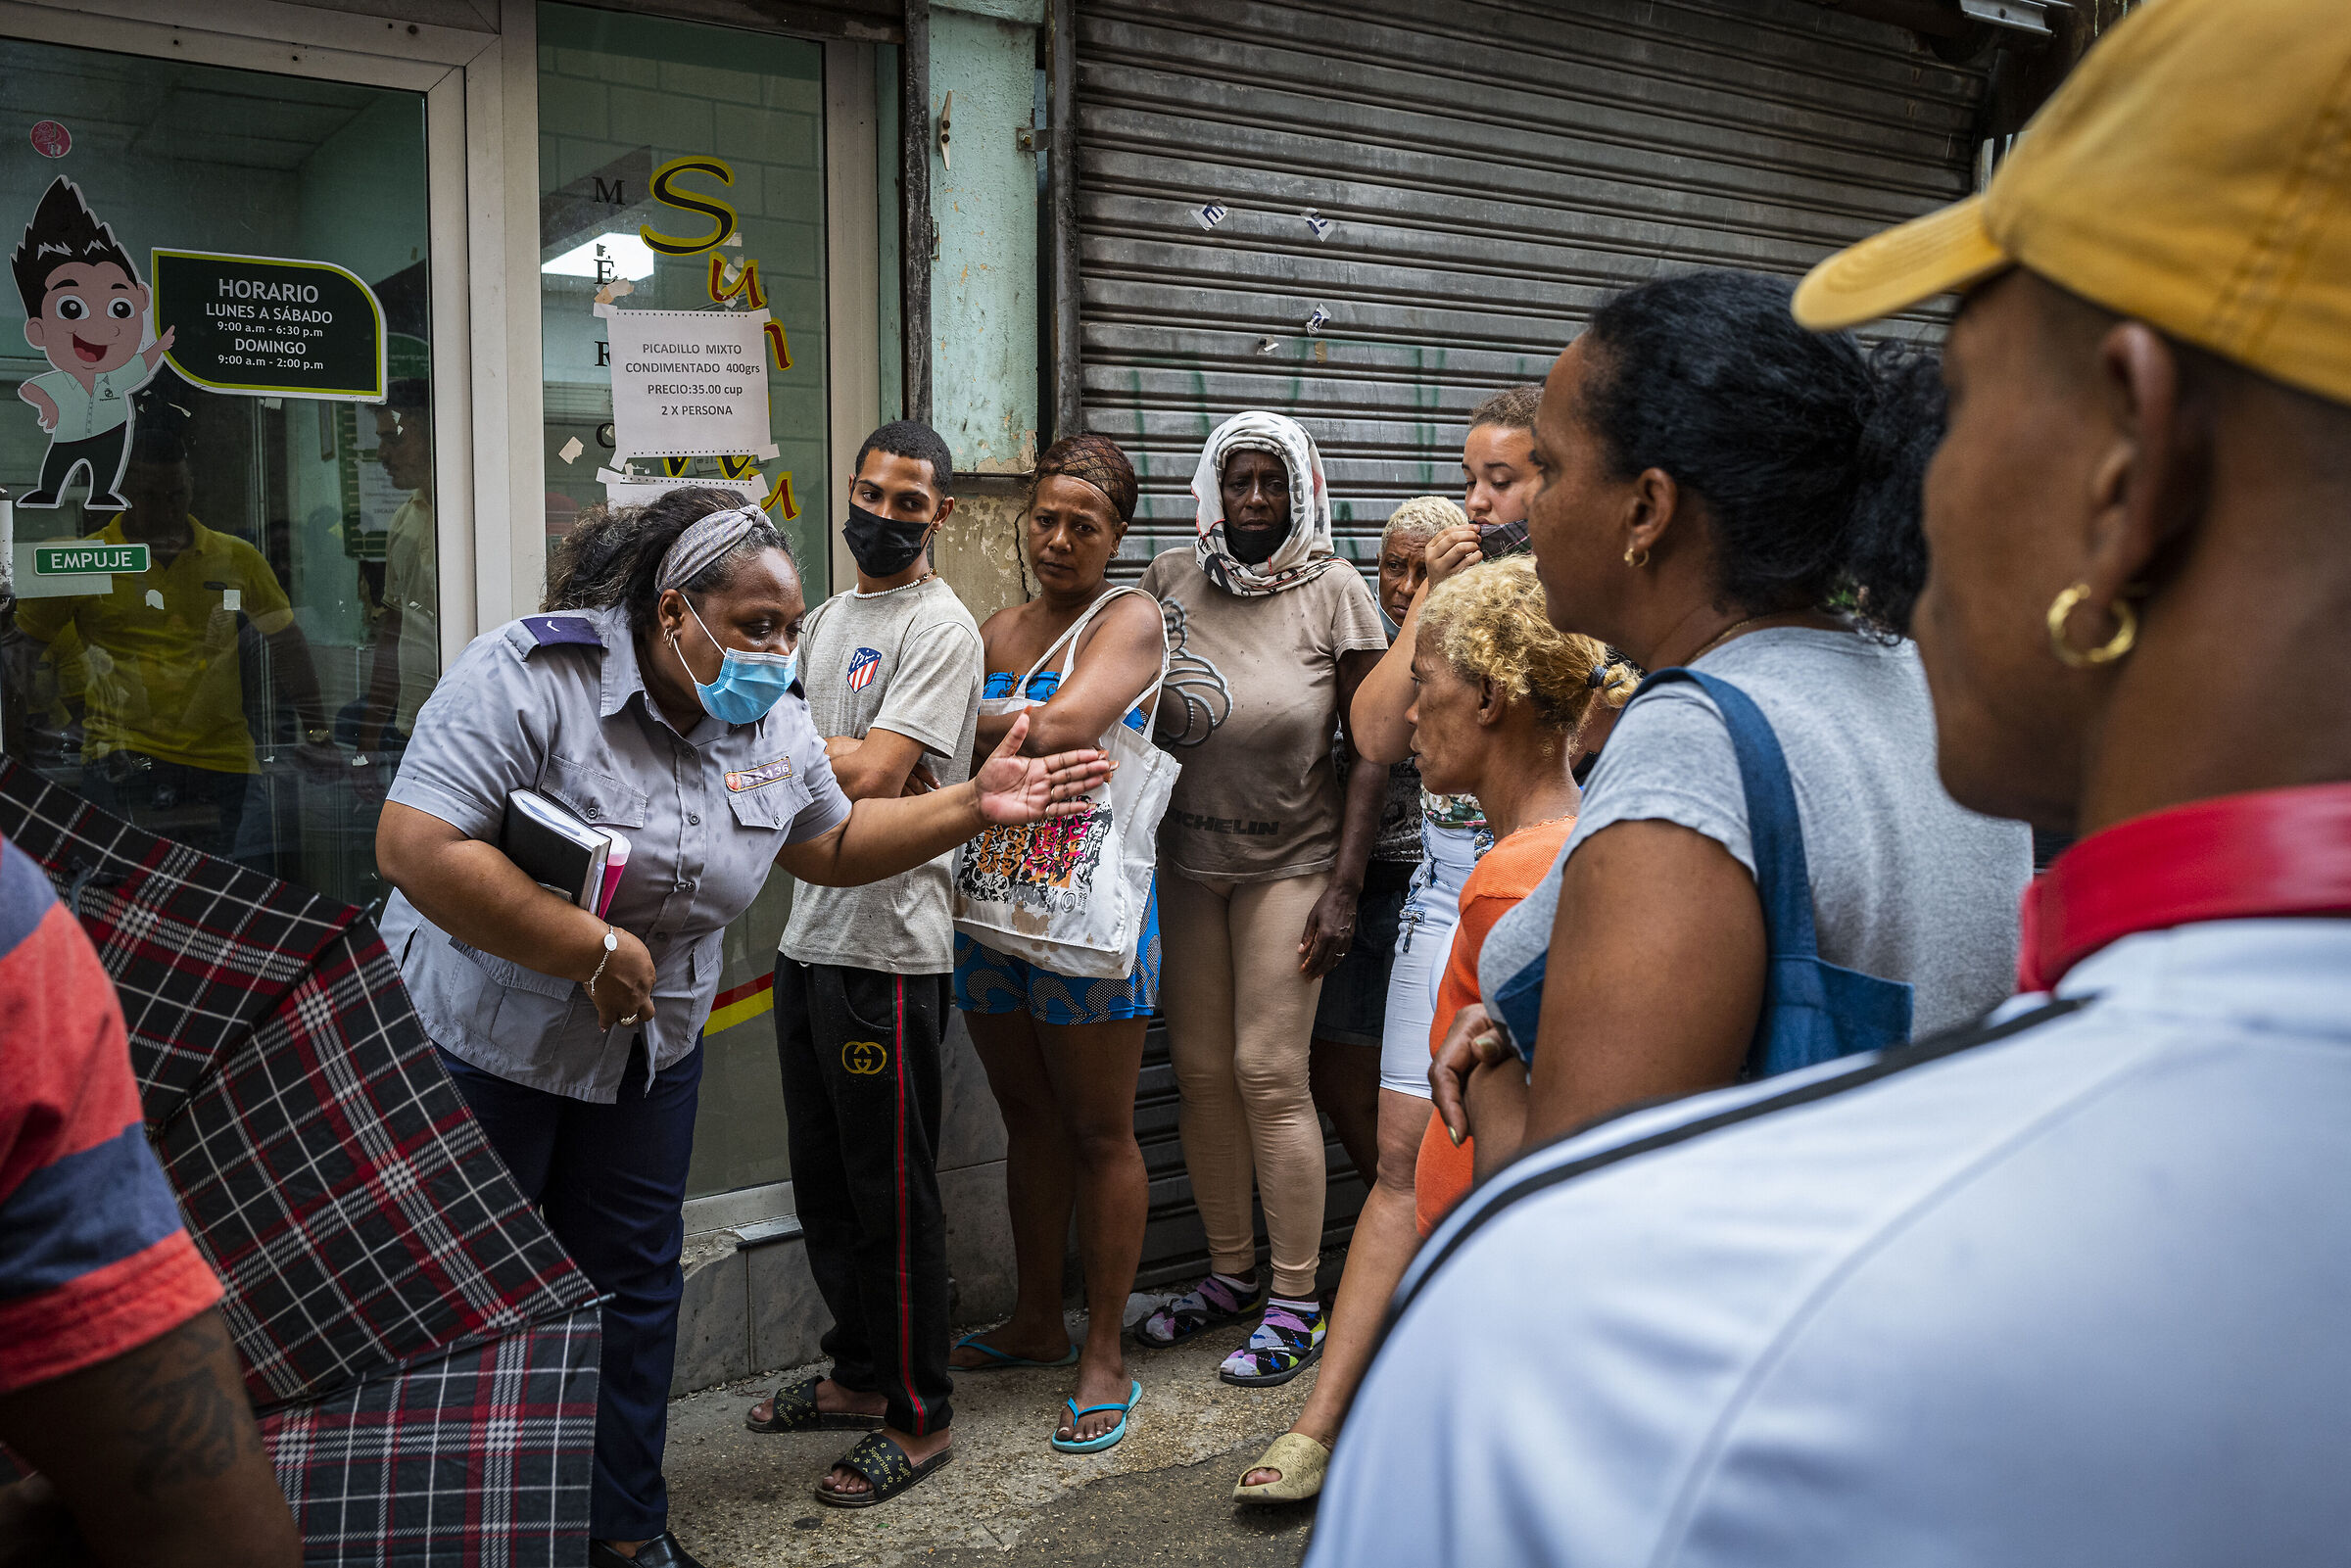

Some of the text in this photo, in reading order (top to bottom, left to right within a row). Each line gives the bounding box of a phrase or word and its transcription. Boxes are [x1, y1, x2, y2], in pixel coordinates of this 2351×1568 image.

[218, 278, 319, 304] HORARIO
[206, 303, 333, 324] LUNES A SÁBADO
[216, 320, 242, 332] 9:00
[245, 324, 265, 333] a.m
[275, 325, 300, 335] 6:30
[303, 328, 323, 338] p.m
[234, 338, 307, 355] DOMINGO
[642, 343, 743, 355] PICADILLO MIXTO
[217, 354, 243, 364] 9:00
[245, 357, 265, 366] a.m
[276, 357, 301, 368] 2:00
[303, 360, 324, 370] p.m
[625, 362, 760, 375] CONDIMENTADO 400grs
[648, 384, 744, 397] PRECIO:35.00 cup
[661, 405, 733, 415] 2 X PERSONA
[51, 550, 133, 569] EMPUJE
[868, 1446, 892, 1475] Superstar
